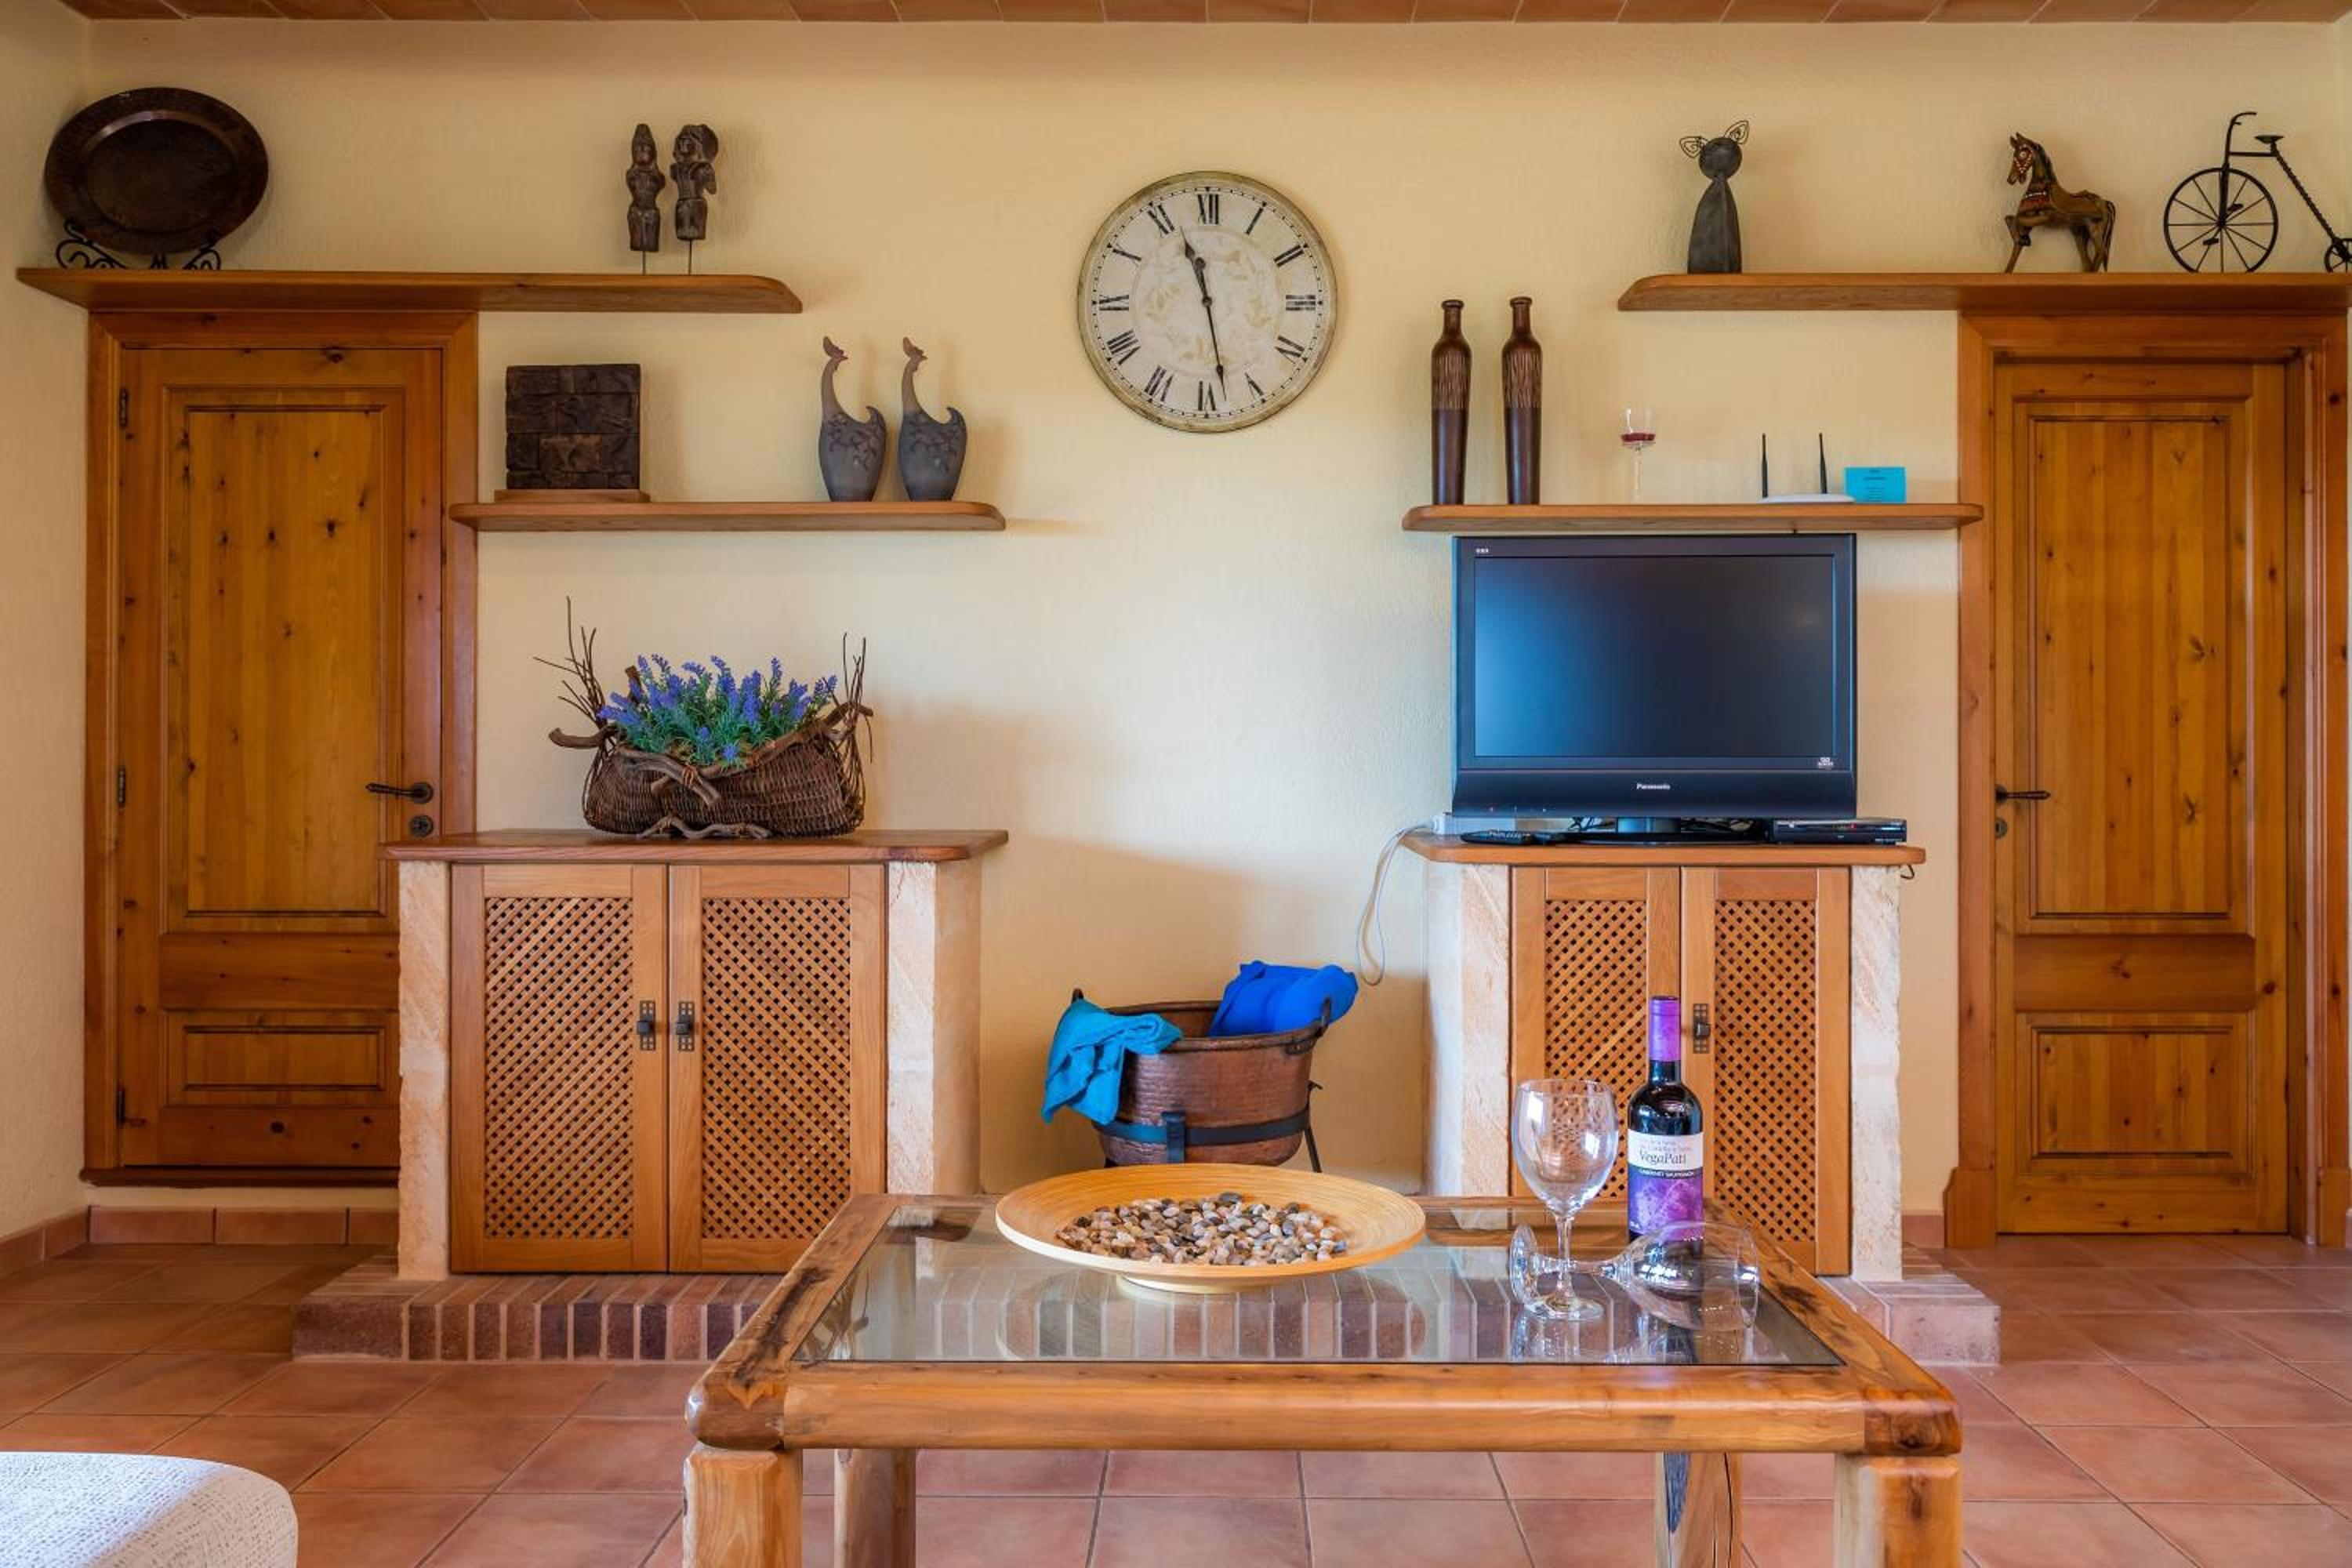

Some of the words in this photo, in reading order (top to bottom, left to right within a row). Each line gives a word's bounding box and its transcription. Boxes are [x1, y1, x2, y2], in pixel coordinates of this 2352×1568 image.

[1146, 204, 1175, 238] XI
[1197, 194, 1220, 225] XII
[1246, 207, 1265, 235] I
[1112, 242, 1142, 267] X
[1273, 244, 1305, 267] II
[1098, 294, 1130, 311] IX
[1285, 294, 1316, 311] III
[1105, 329, 1142, 365] VIII
[1274, 336, 1305, 365] IV
[1144, 365, 1175, 402] VII
[1197, 380, 1217, 412] VI
[1245, 371, 1265, 397] V
